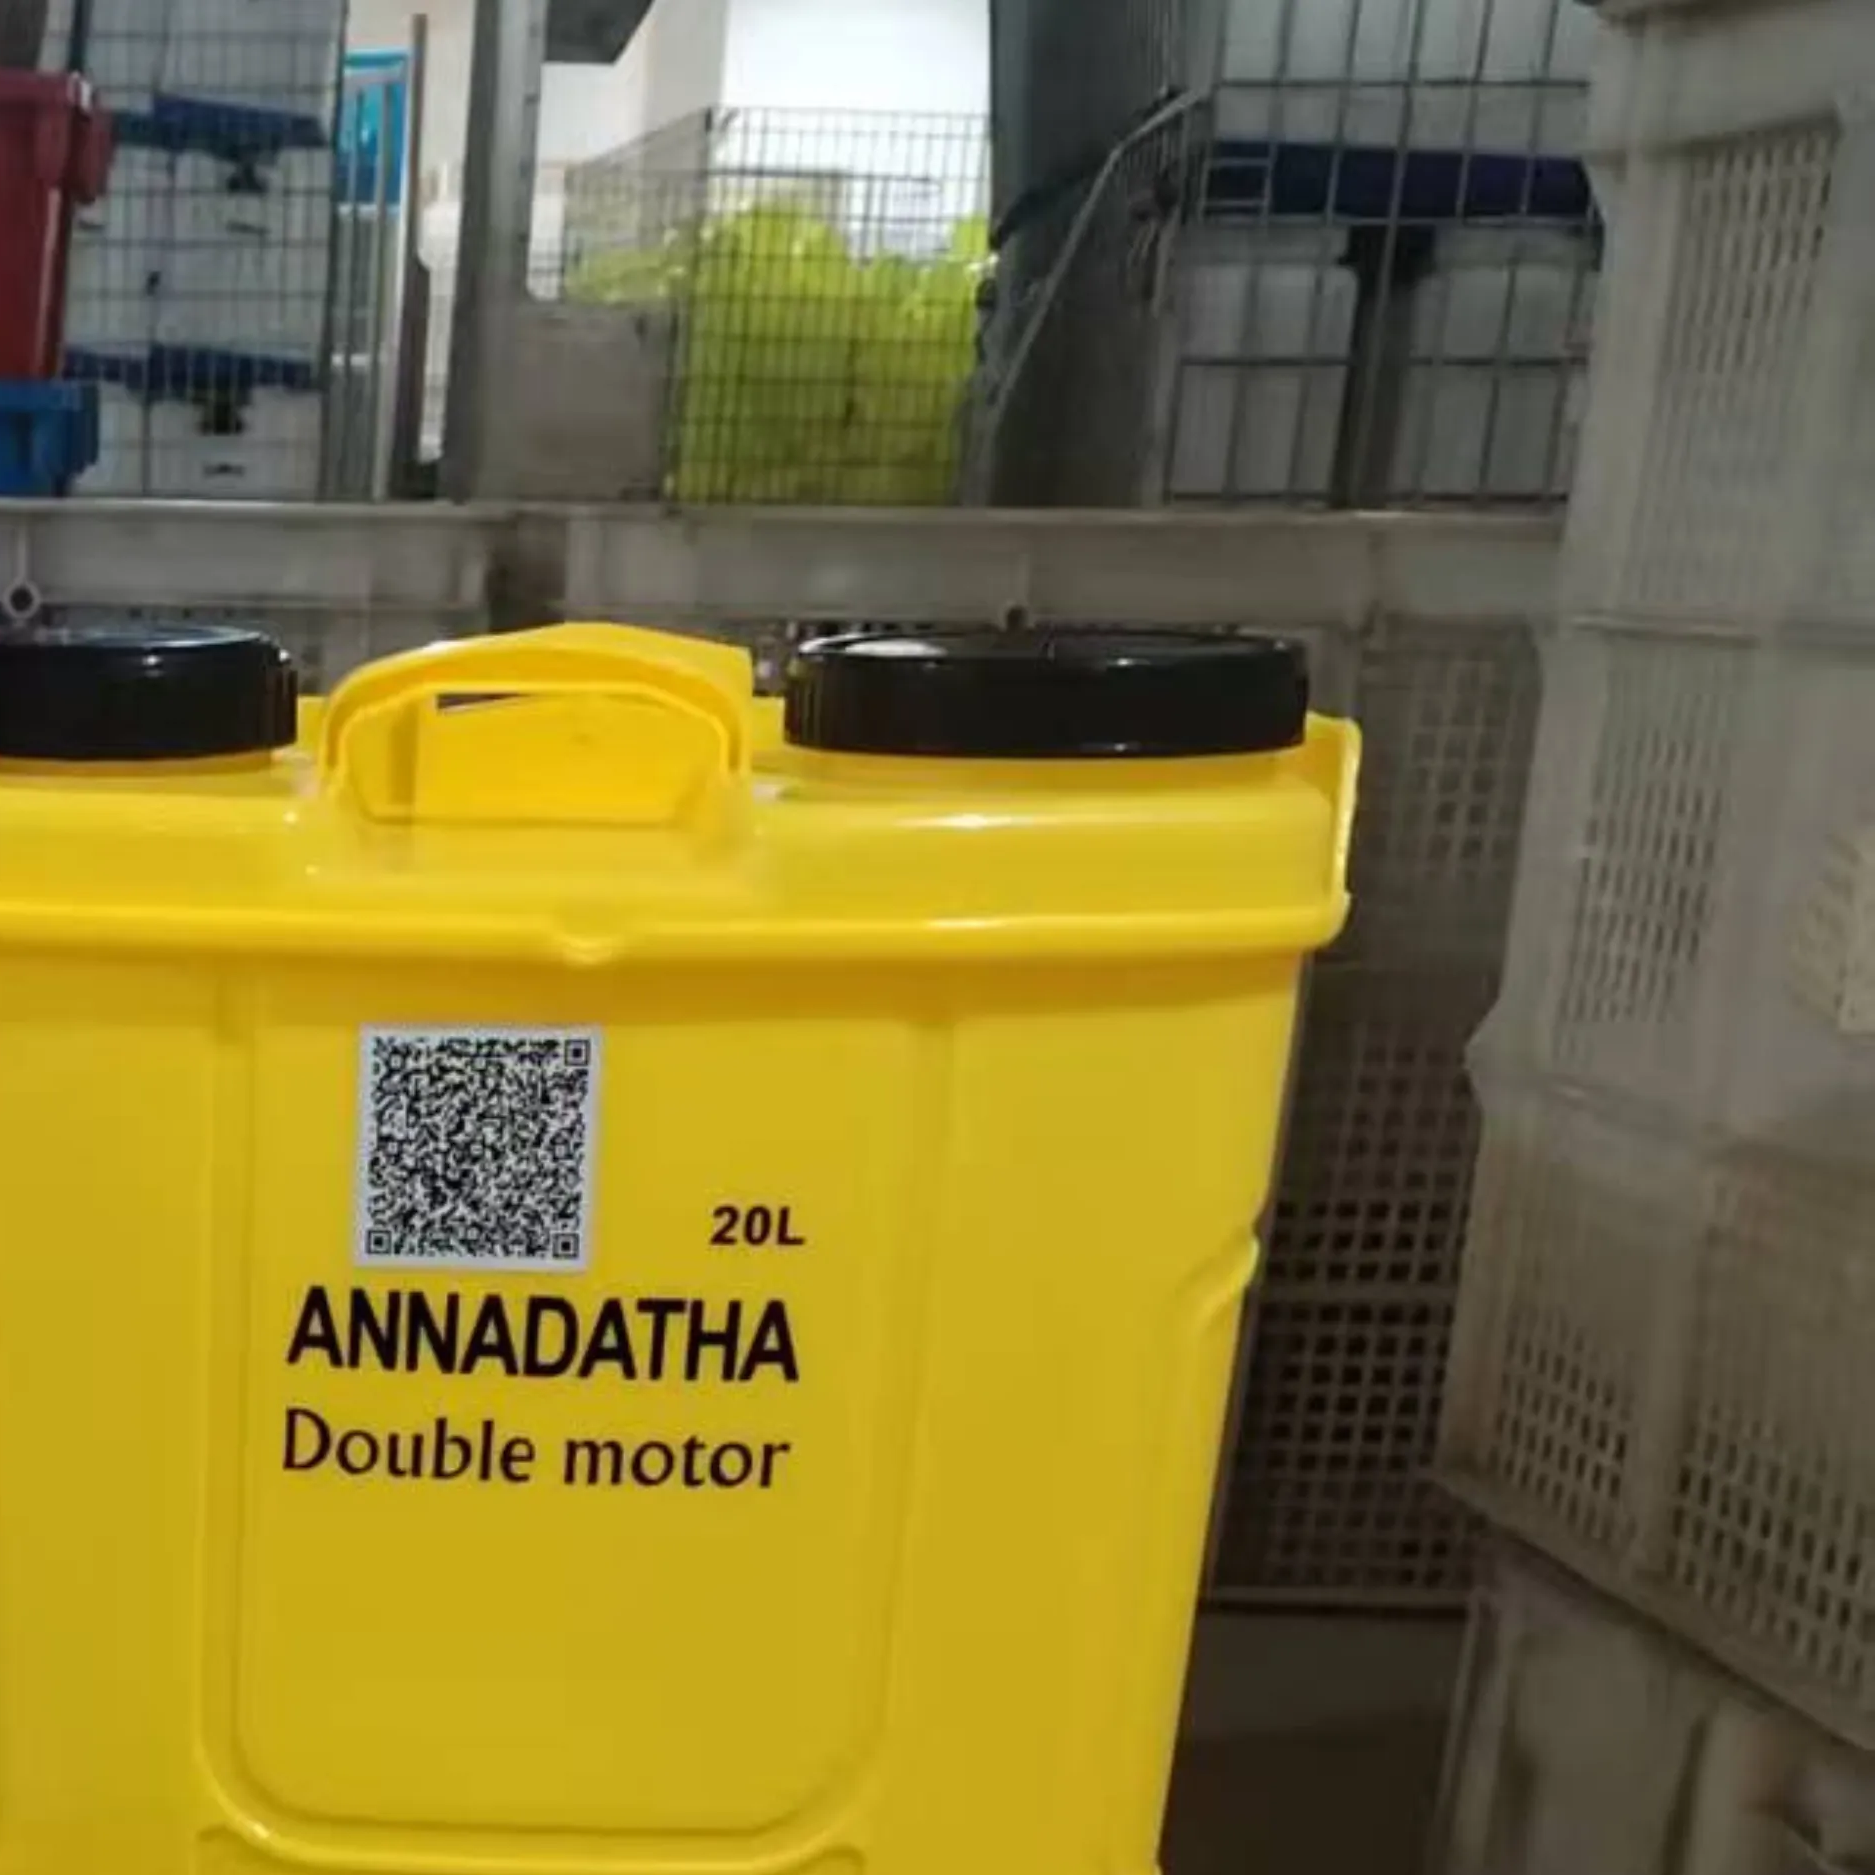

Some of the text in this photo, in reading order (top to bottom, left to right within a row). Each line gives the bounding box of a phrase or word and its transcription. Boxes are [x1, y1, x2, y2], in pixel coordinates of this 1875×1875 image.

[709, 1204, 806, 1247] 20L
[286, 1284, 800, 1383] ANNADATHA
[281, 1406, 792, 1489] Double motor
